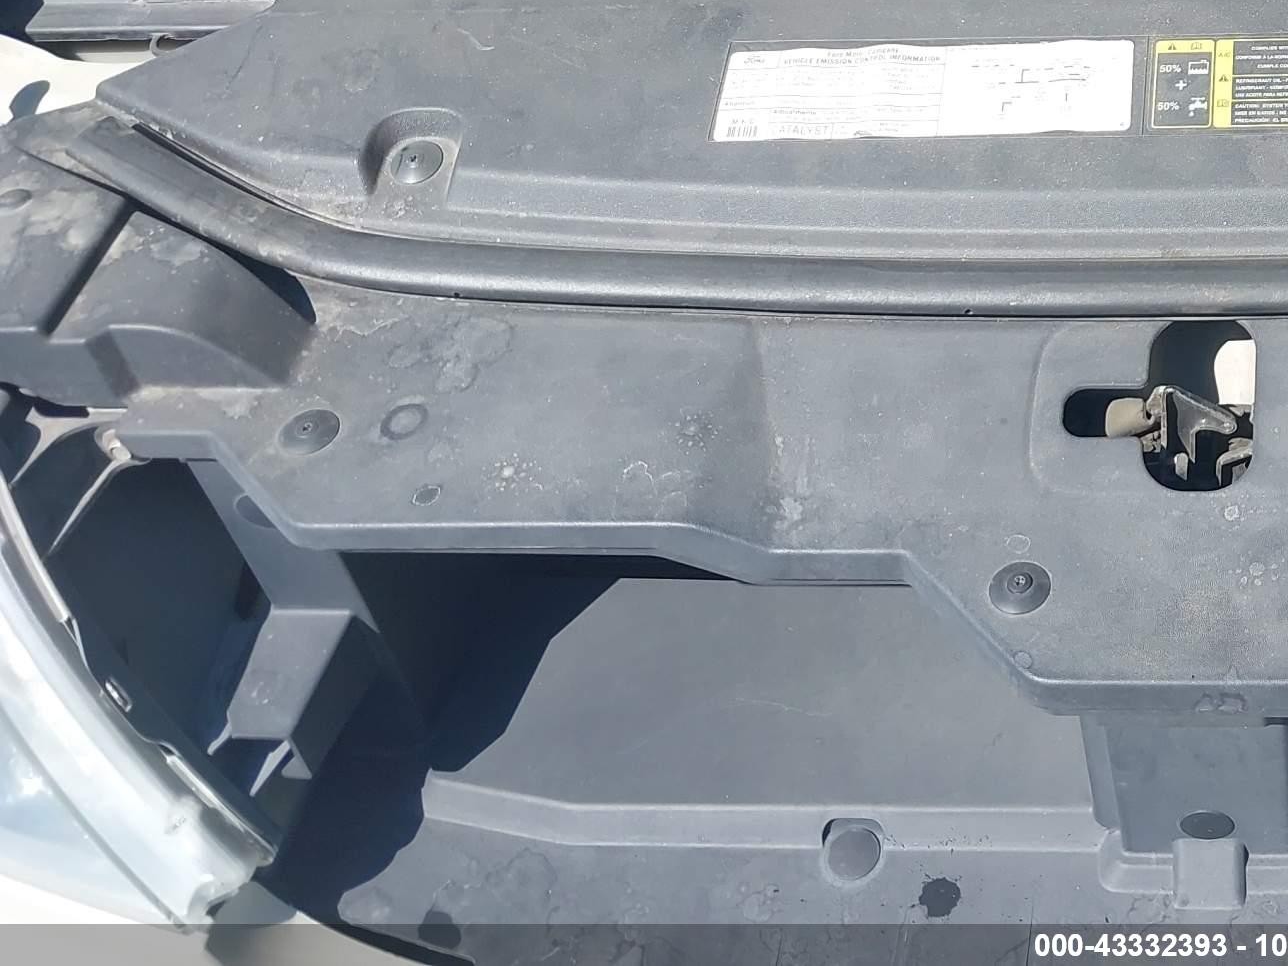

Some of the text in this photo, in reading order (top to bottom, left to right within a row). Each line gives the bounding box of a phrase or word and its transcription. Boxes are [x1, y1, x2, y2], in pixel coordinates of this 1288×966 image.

[815, 57, 853, 65] EMISSION
[1159, 63, 1182, 73] 50%
[1157, 101, 1180, 111] 50%
